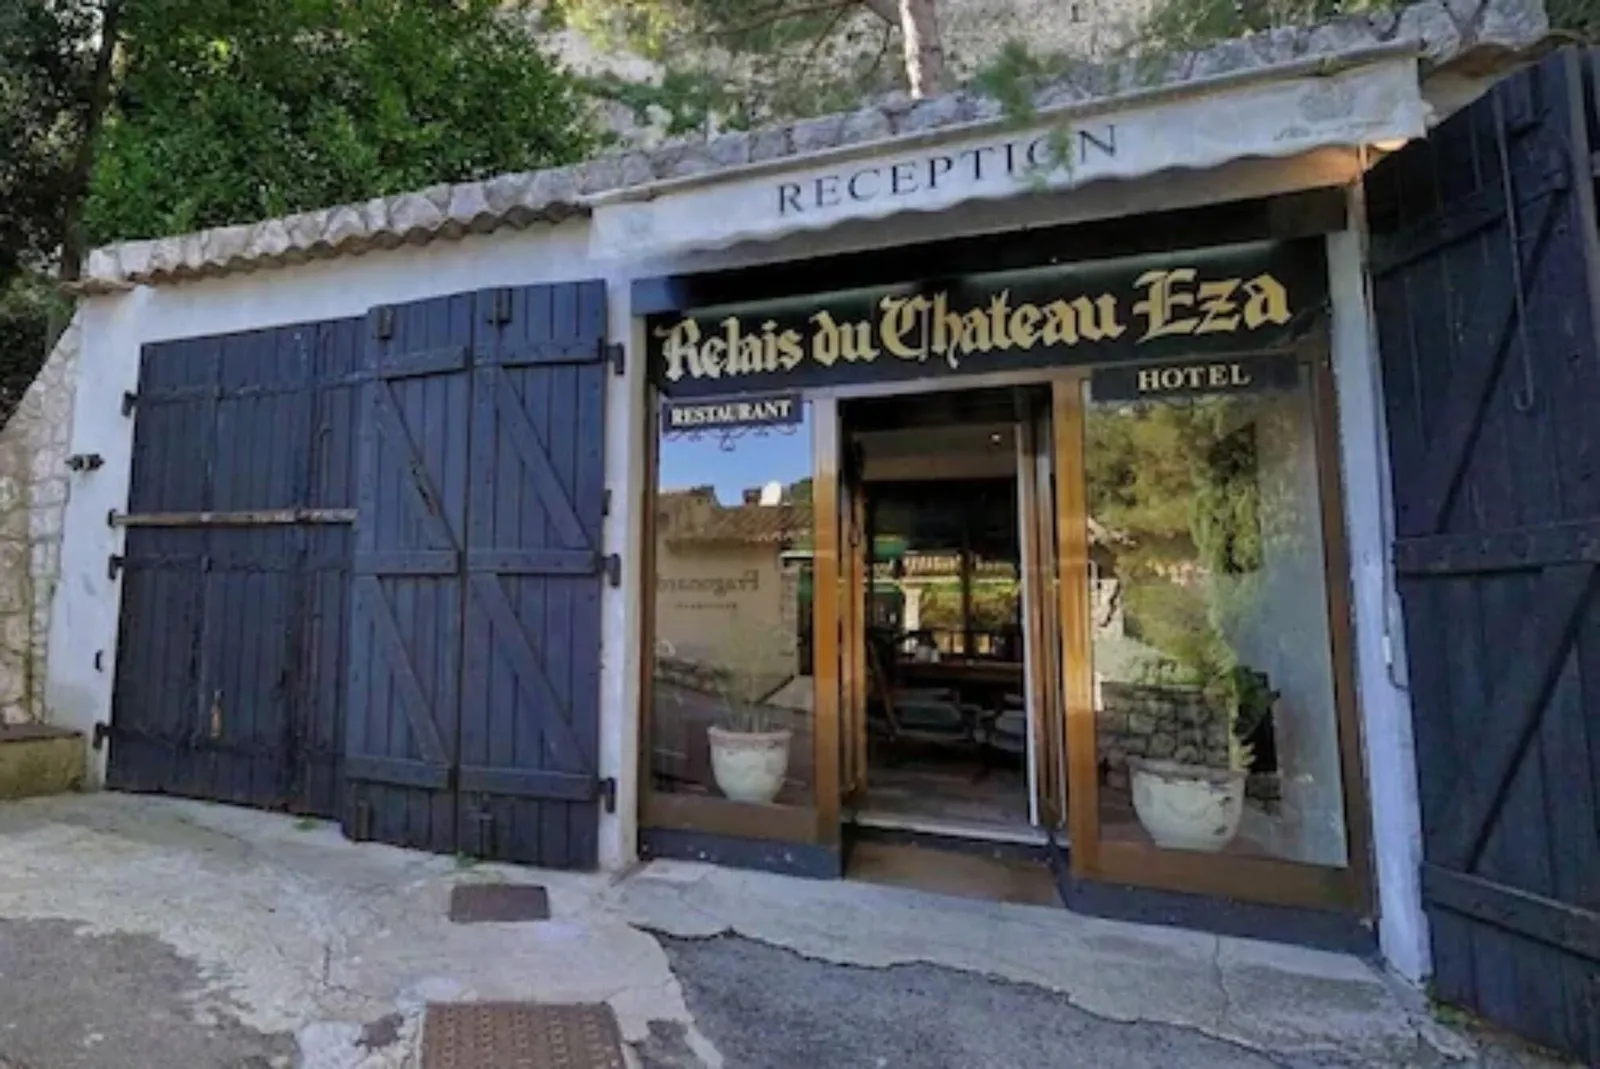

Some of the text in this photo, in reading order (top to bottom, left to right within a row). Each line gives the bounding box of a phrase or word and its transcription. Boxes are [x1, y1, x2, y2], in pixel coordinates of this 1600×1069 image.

[777, 123, 1117, 217] RECEPTION
[654, 267, 1293, 382] Relais du Chateau Eza
[1138, 363, 1251, 391] HOTEL
[671, 399, 792, 427] RESTAURANT
